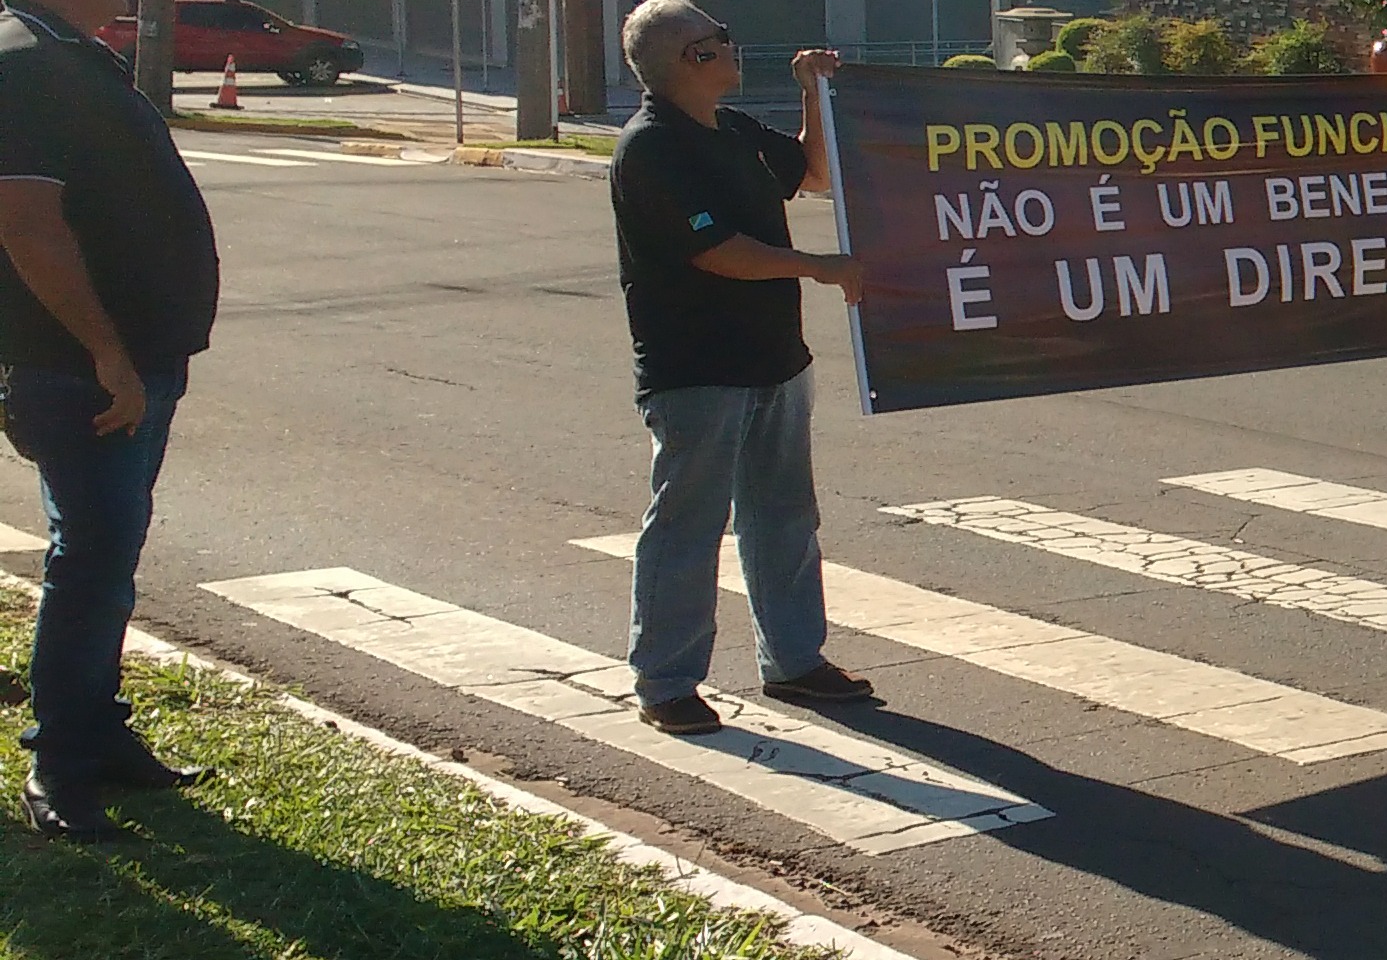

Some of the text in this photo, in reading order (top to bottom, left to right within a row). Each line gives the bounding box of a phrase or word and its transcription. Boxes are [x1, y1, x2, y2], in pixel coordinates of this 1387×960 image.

[925, 108, 1241, 174] PROMOÇÃO
[934, 180, 1055, 240] NÃO
[1090, 173, 1126, 232] É
[1157, 180, 1235, 228] UM
[946, 247, 999, 332] É
[1055, 252, 1170, 322] UM
